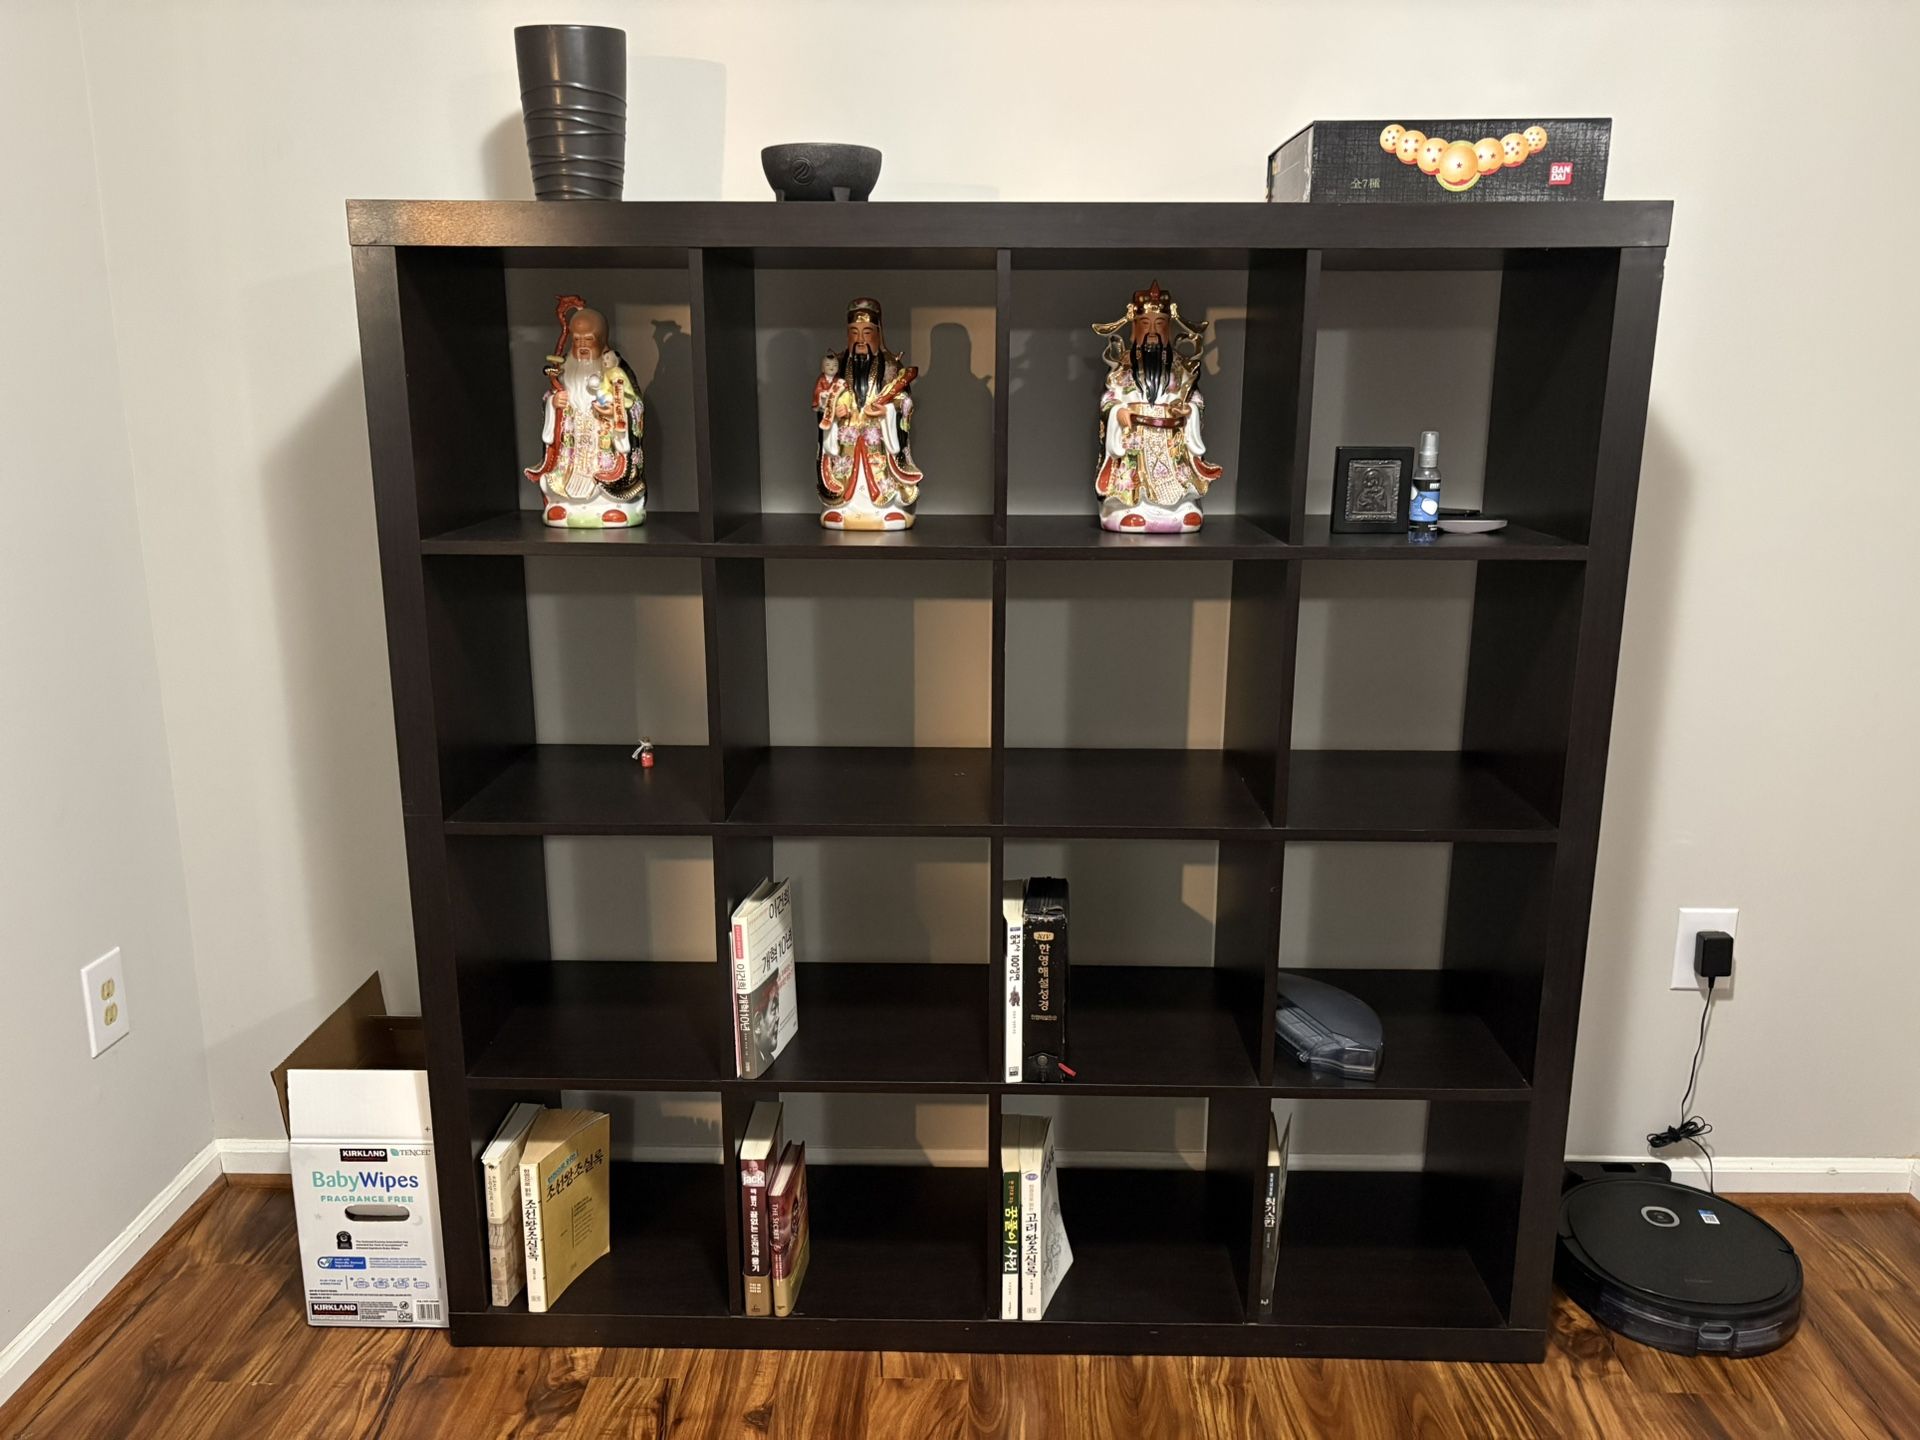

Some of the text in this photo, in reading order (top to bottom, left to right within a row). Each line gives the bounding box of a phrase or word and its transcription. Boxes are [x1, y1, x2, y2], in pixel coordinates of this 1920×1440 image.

[1551, 165, 1571, 174] BAN
[1551, 173, 1566, 181] DAI
[768, 886, 791, 919] 이건희
[736, 963, 746, 990] 이건희
[546, 1148, 604, 1202] 조선왕조실록
[742, 1173, 764, 1186] jack
[320, 1195, 414, 1203] FRAGRANCE FREE
[525, 1199, 539, 1261] 조선왕조실록
[1005, 1206, 1018, 1272] 꿈풀이 사전
[1025, 1213, 1038, 1278] 고려왕조실록
[313, 1303, 357, 1311] KIRKLAND
